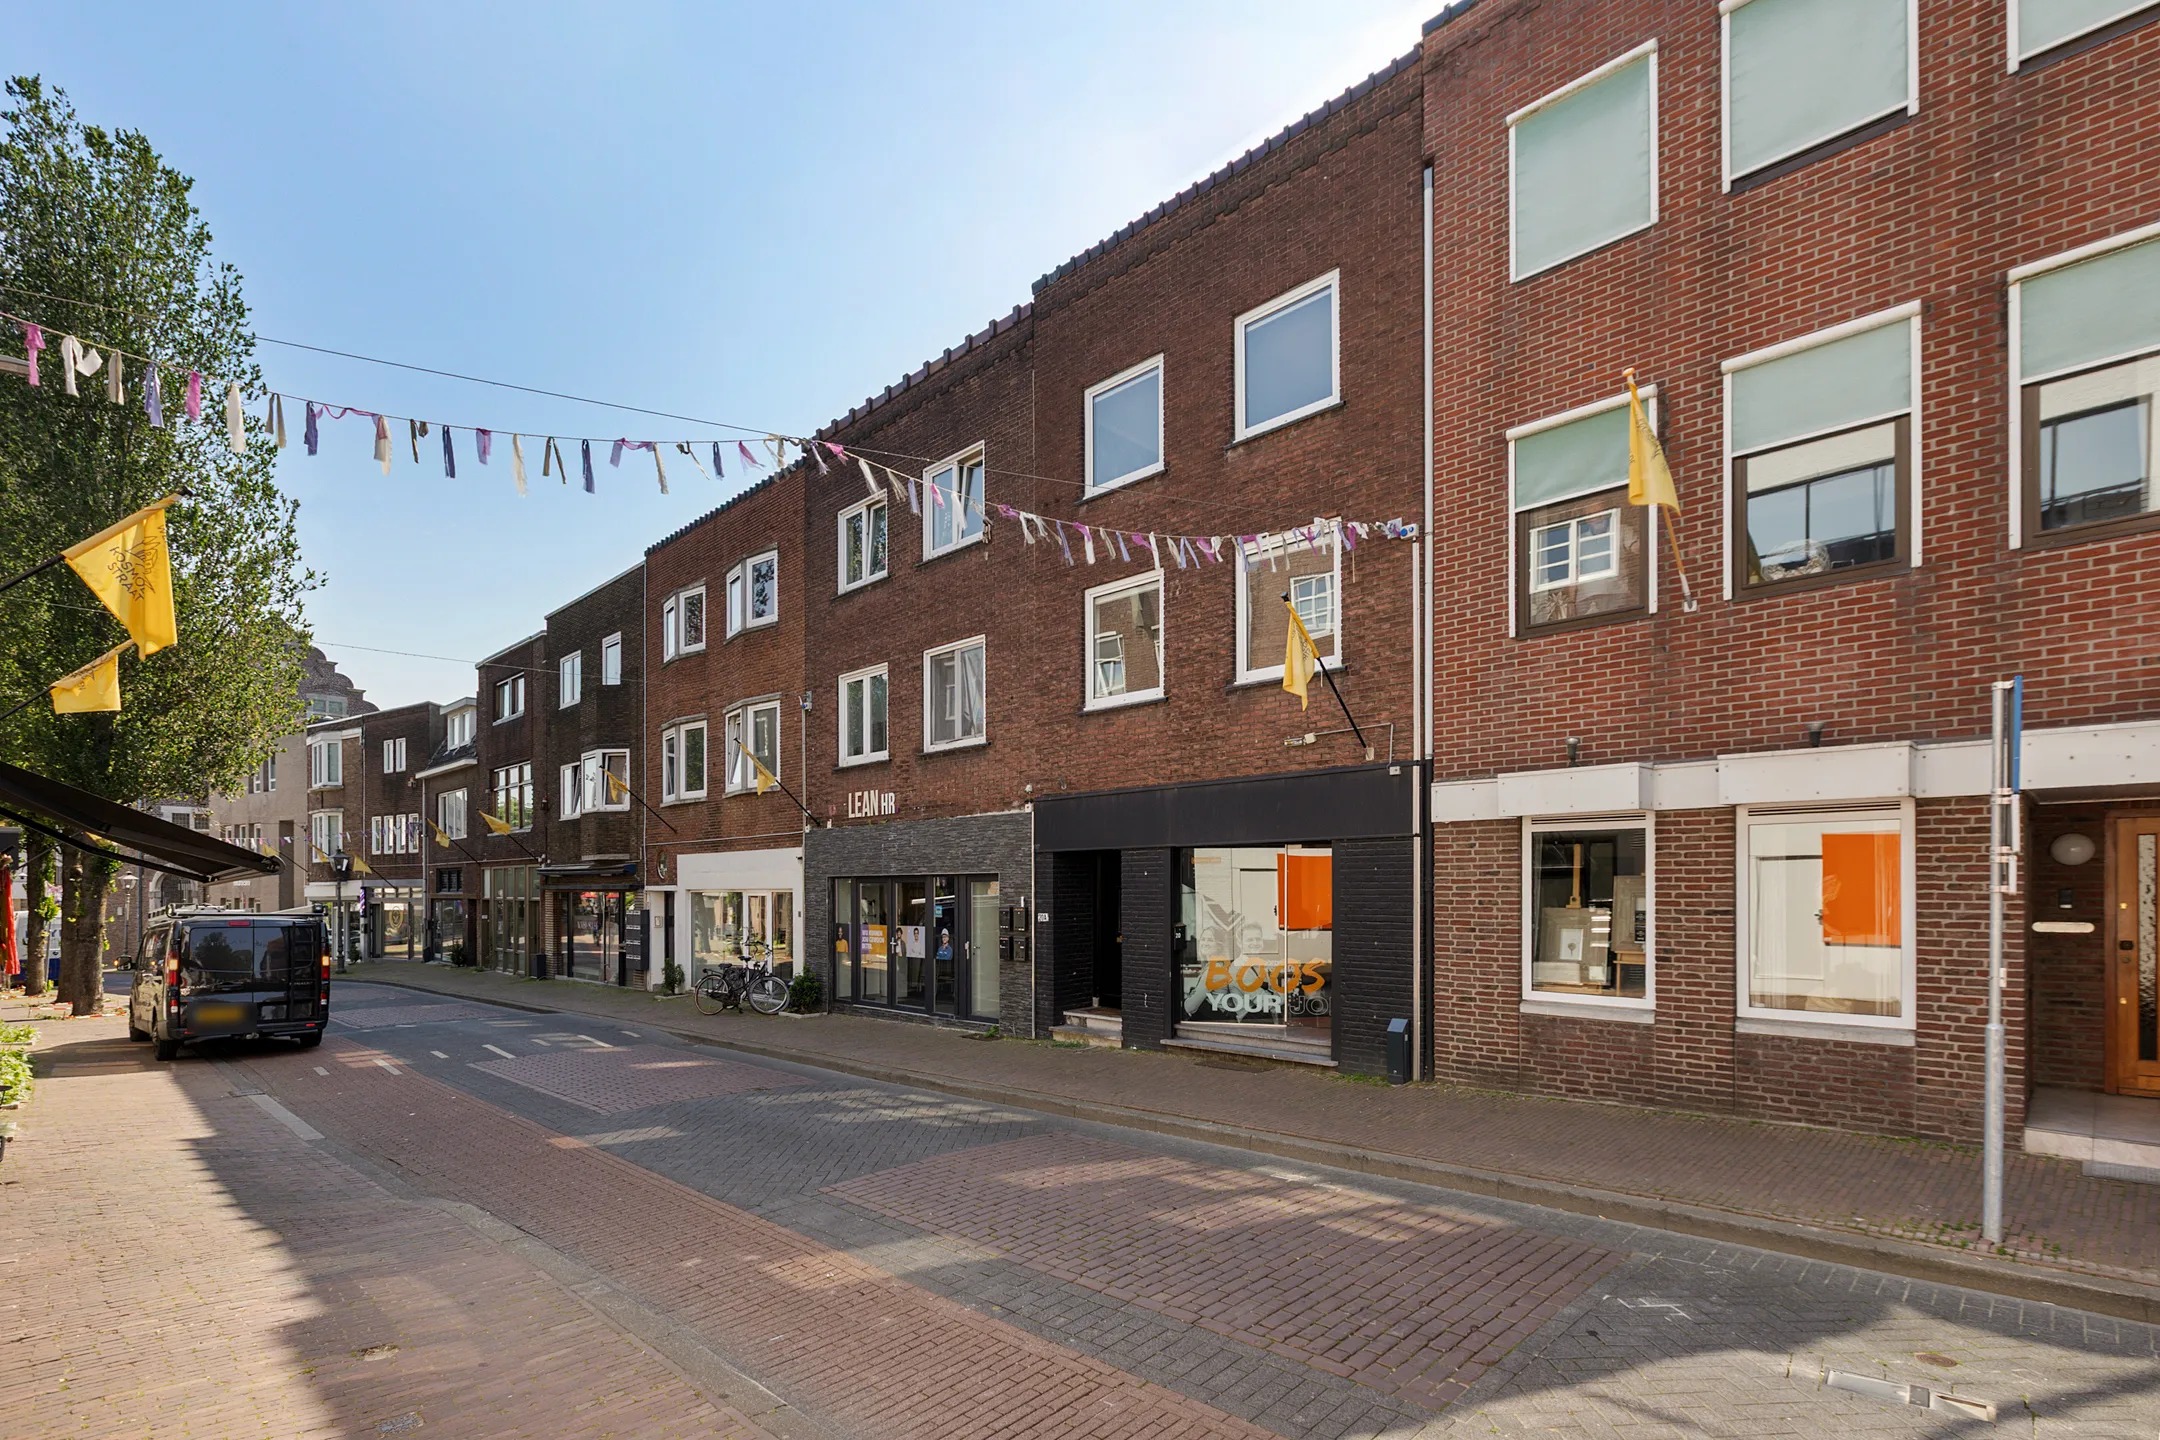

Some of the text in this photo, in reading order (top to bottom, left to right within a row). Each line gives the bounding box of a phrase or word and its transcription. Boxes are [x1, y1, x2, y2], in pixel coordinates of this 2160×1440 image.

[107, 562, 146, 602] STRAAT
[848, 789, 879, 818] LEAN
[1205, 954, 1326, 995] BOOS
[1206, 992, 1332, 1017] YOUR JO
